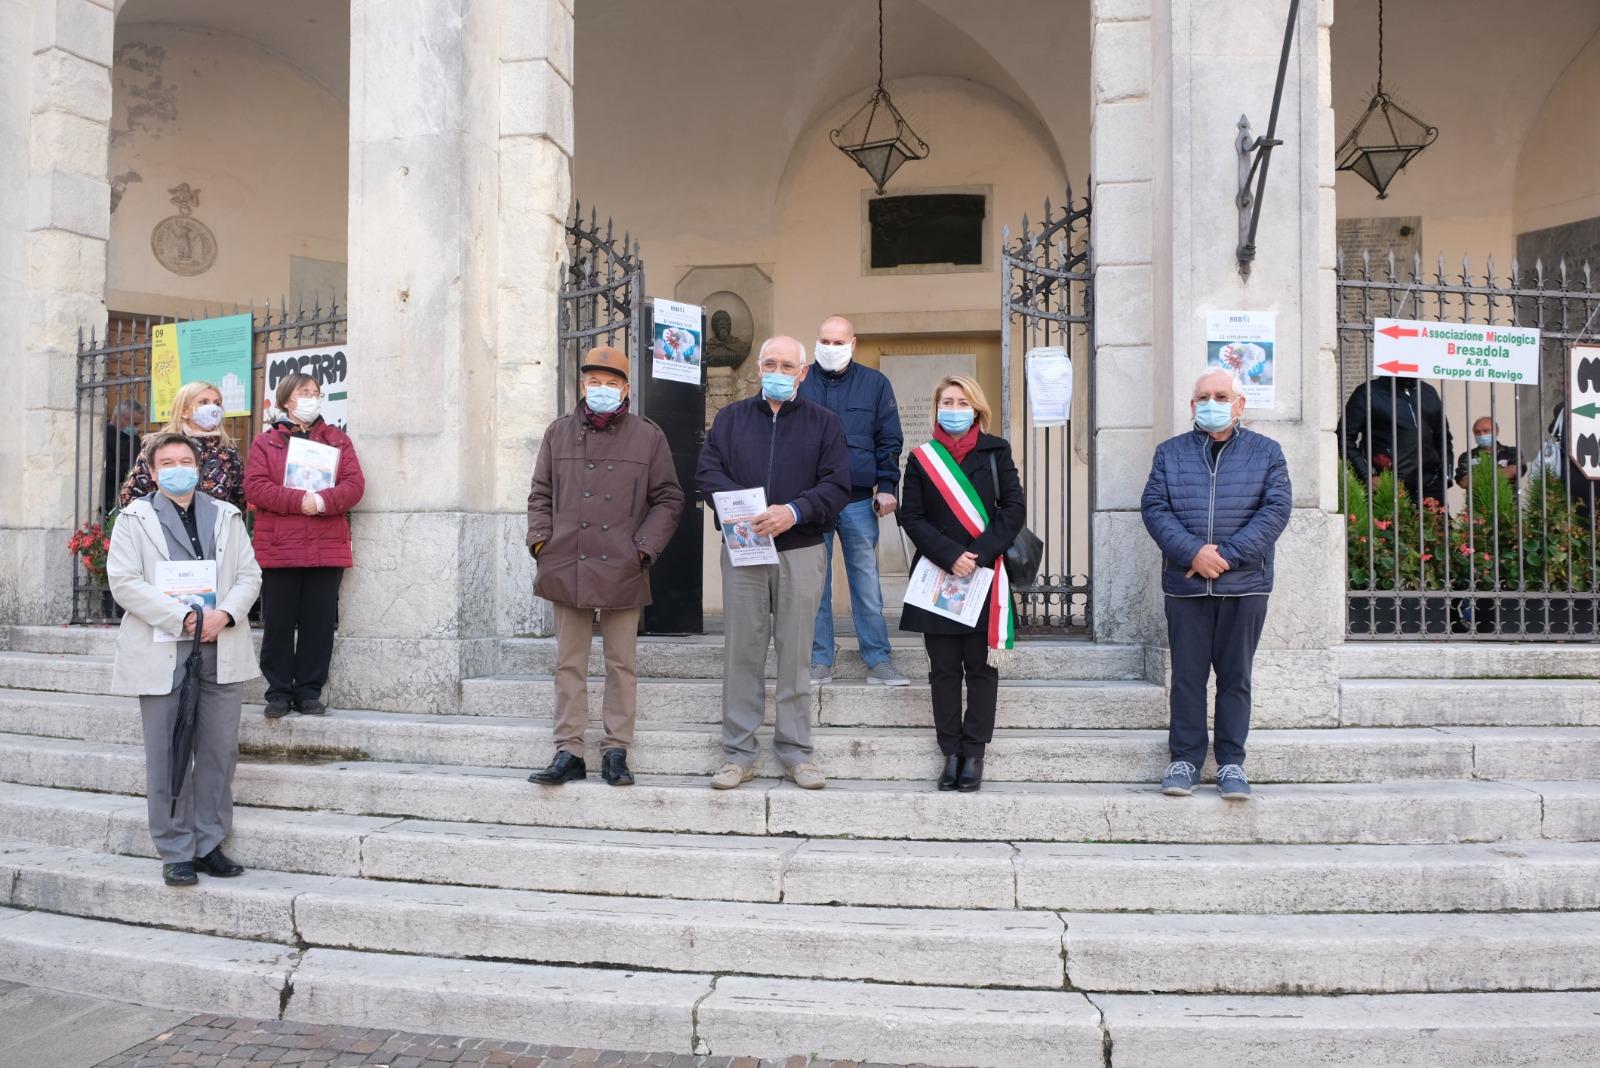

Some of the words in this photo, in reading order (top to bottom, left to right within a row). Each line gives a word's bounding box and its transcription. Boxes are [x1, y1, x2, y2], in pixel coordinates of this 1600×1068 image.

[155, 328, 164, 338] 09
[1421, 327, 1483, 341] Associazione
[1486, 331, 1536, 346] Micologica
[1447, 343, 1509, 358] Bresadola
[1466, 358, 1491, 367] A.P.S.
[1433, 366, 1471, 378] Gruppo
[1475, 367, 1485, 377] di
[1488, 369, 1523, 381] Rovigo
